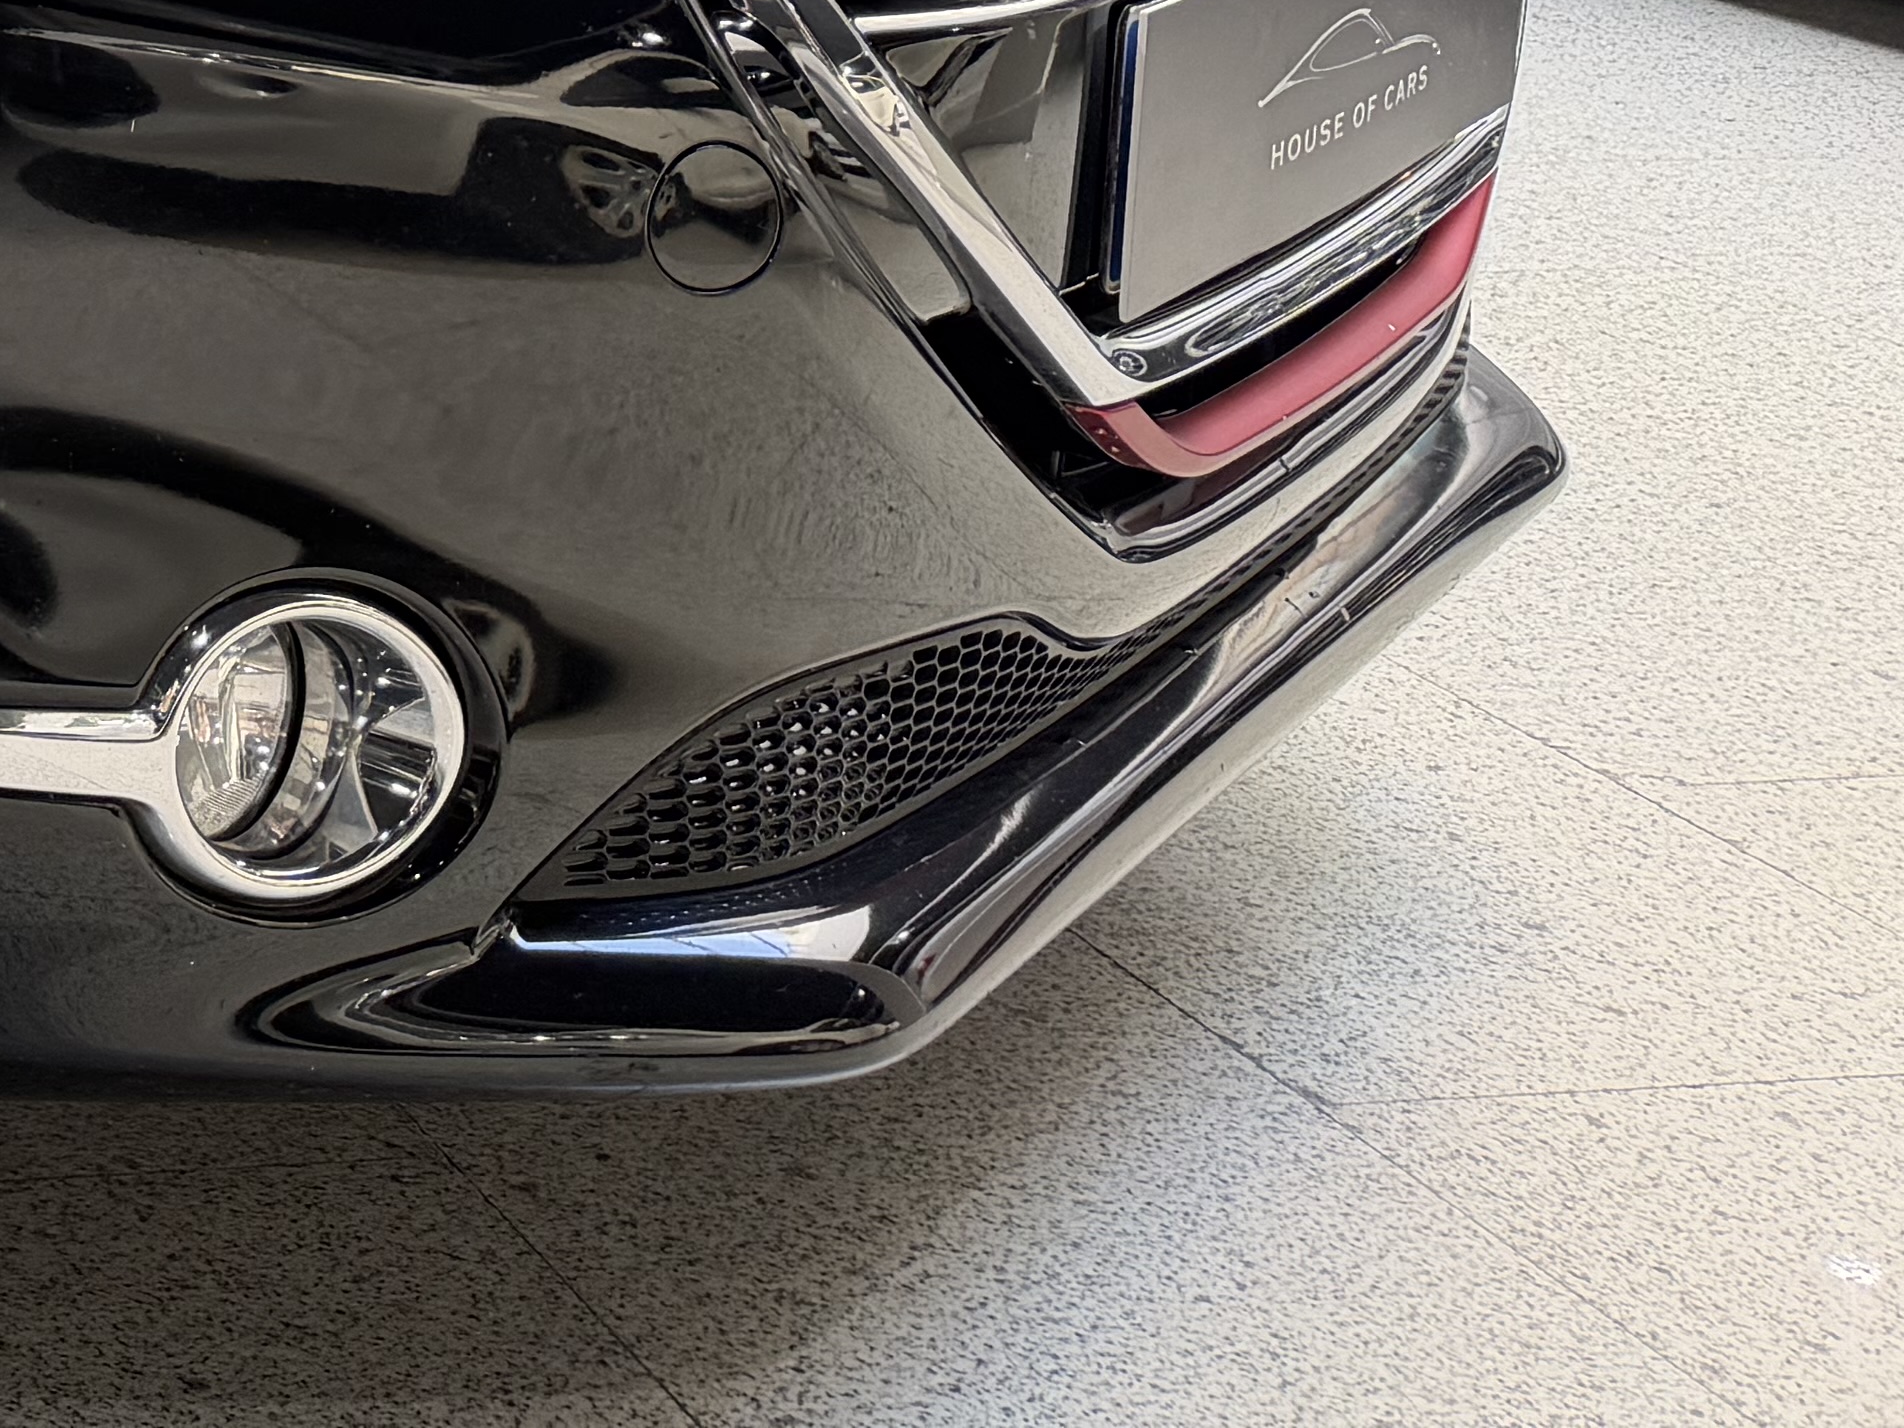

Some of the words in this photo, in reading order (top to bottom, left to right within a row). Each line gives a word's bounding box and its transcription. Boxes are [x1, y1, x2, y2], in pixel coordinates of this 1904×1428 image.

[1270, 111, 1345, 171] HOUSE
[1352, 94, 1378, 129] OF
[1384, 64, 1429, 111] CARS
